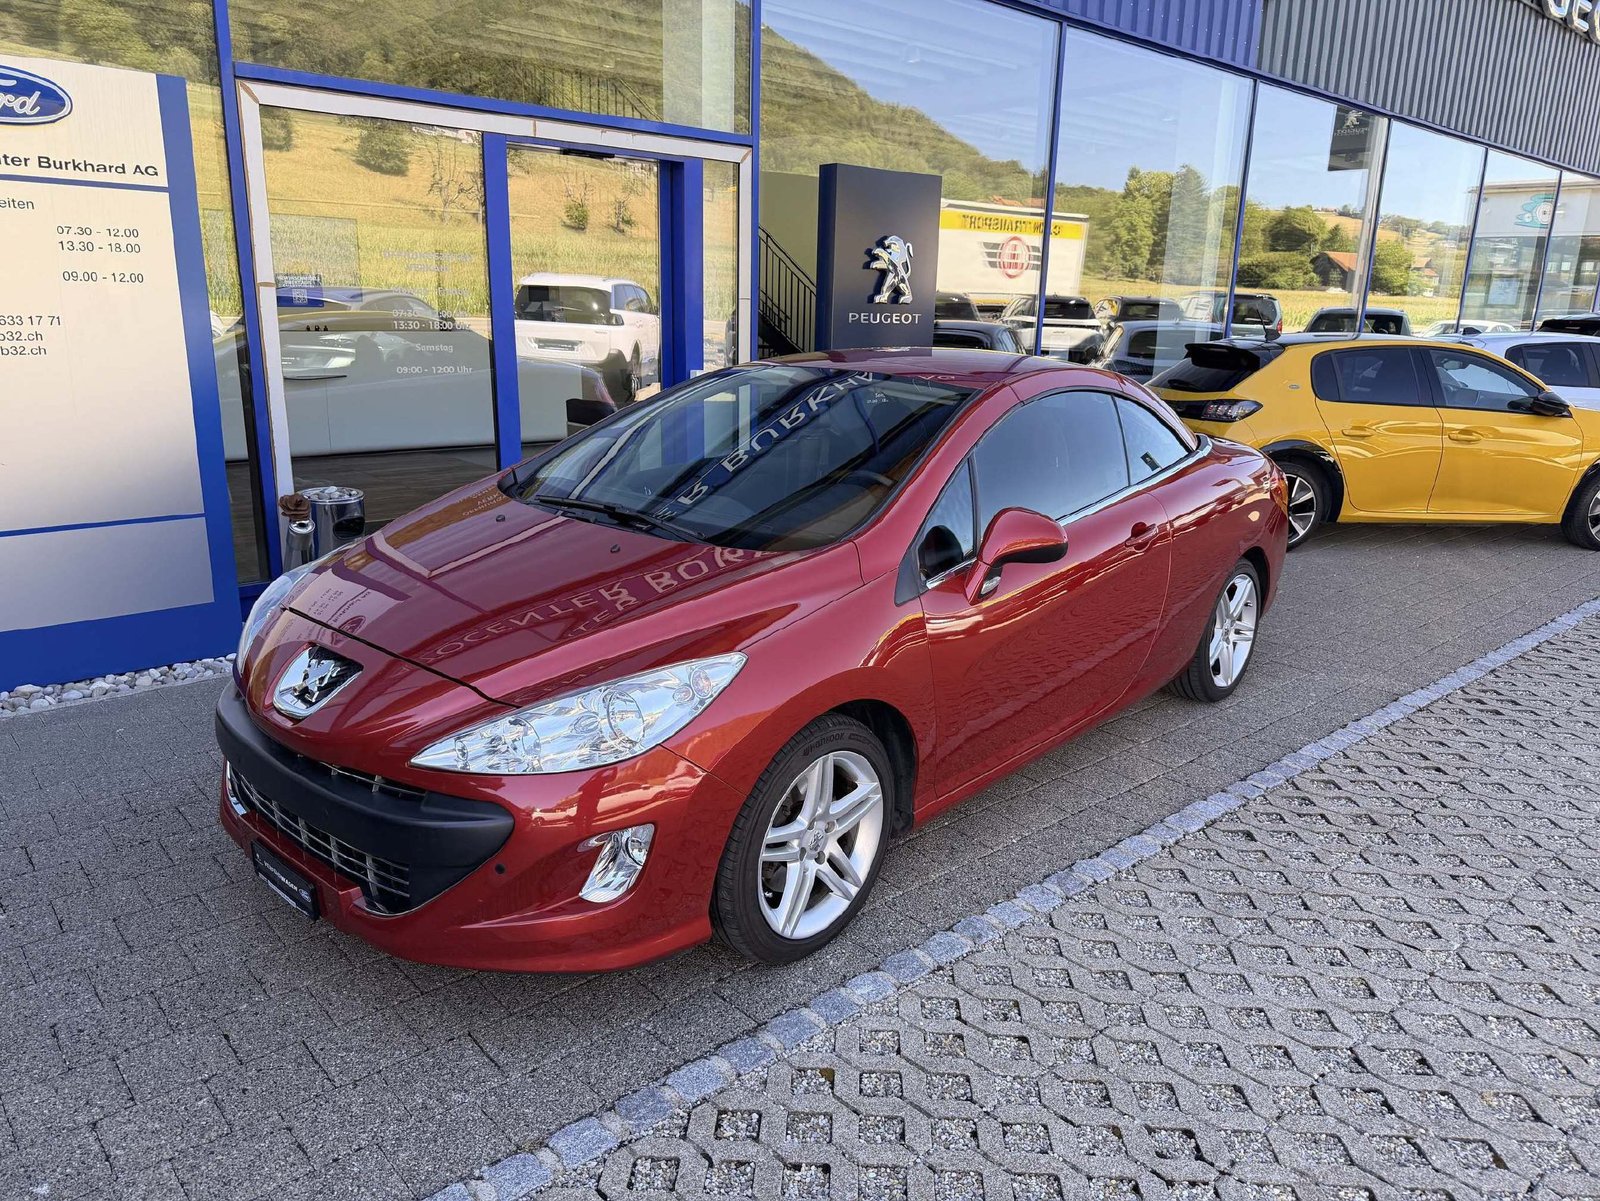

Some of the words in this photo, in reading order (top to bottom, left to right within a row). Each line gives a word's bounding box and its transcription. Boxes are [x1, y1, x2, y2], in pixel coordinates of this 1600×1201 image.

[0, 153, 30, 167] ter
[37, 155, 126, 174] Burkhard
[132, 164, 159, 176] AG
[56, 225, 93, 236] 07.30
[106, 228, 140, 238] 12.00
[58, 240, 95, 252] 13.30
[108, 243, 141, 254] 18.00
[62, 270, 98, 282] 09.00
[111, 272, 144, 283] 12.00
[28, 315, 43, 326] 17
[47, 315, 61, 326] 71
[848, 312, 922, 324] PEUGEOT
[393, 320, 420, 330] 13:30
[429, 320, 453, 330] 18:00
[415, 343, 454, 353] Samstag
[396, 365, 423, 374] 09:00
[432, 366, 455, 374] 12:00
[457, 364, 473, 374] Uhr
